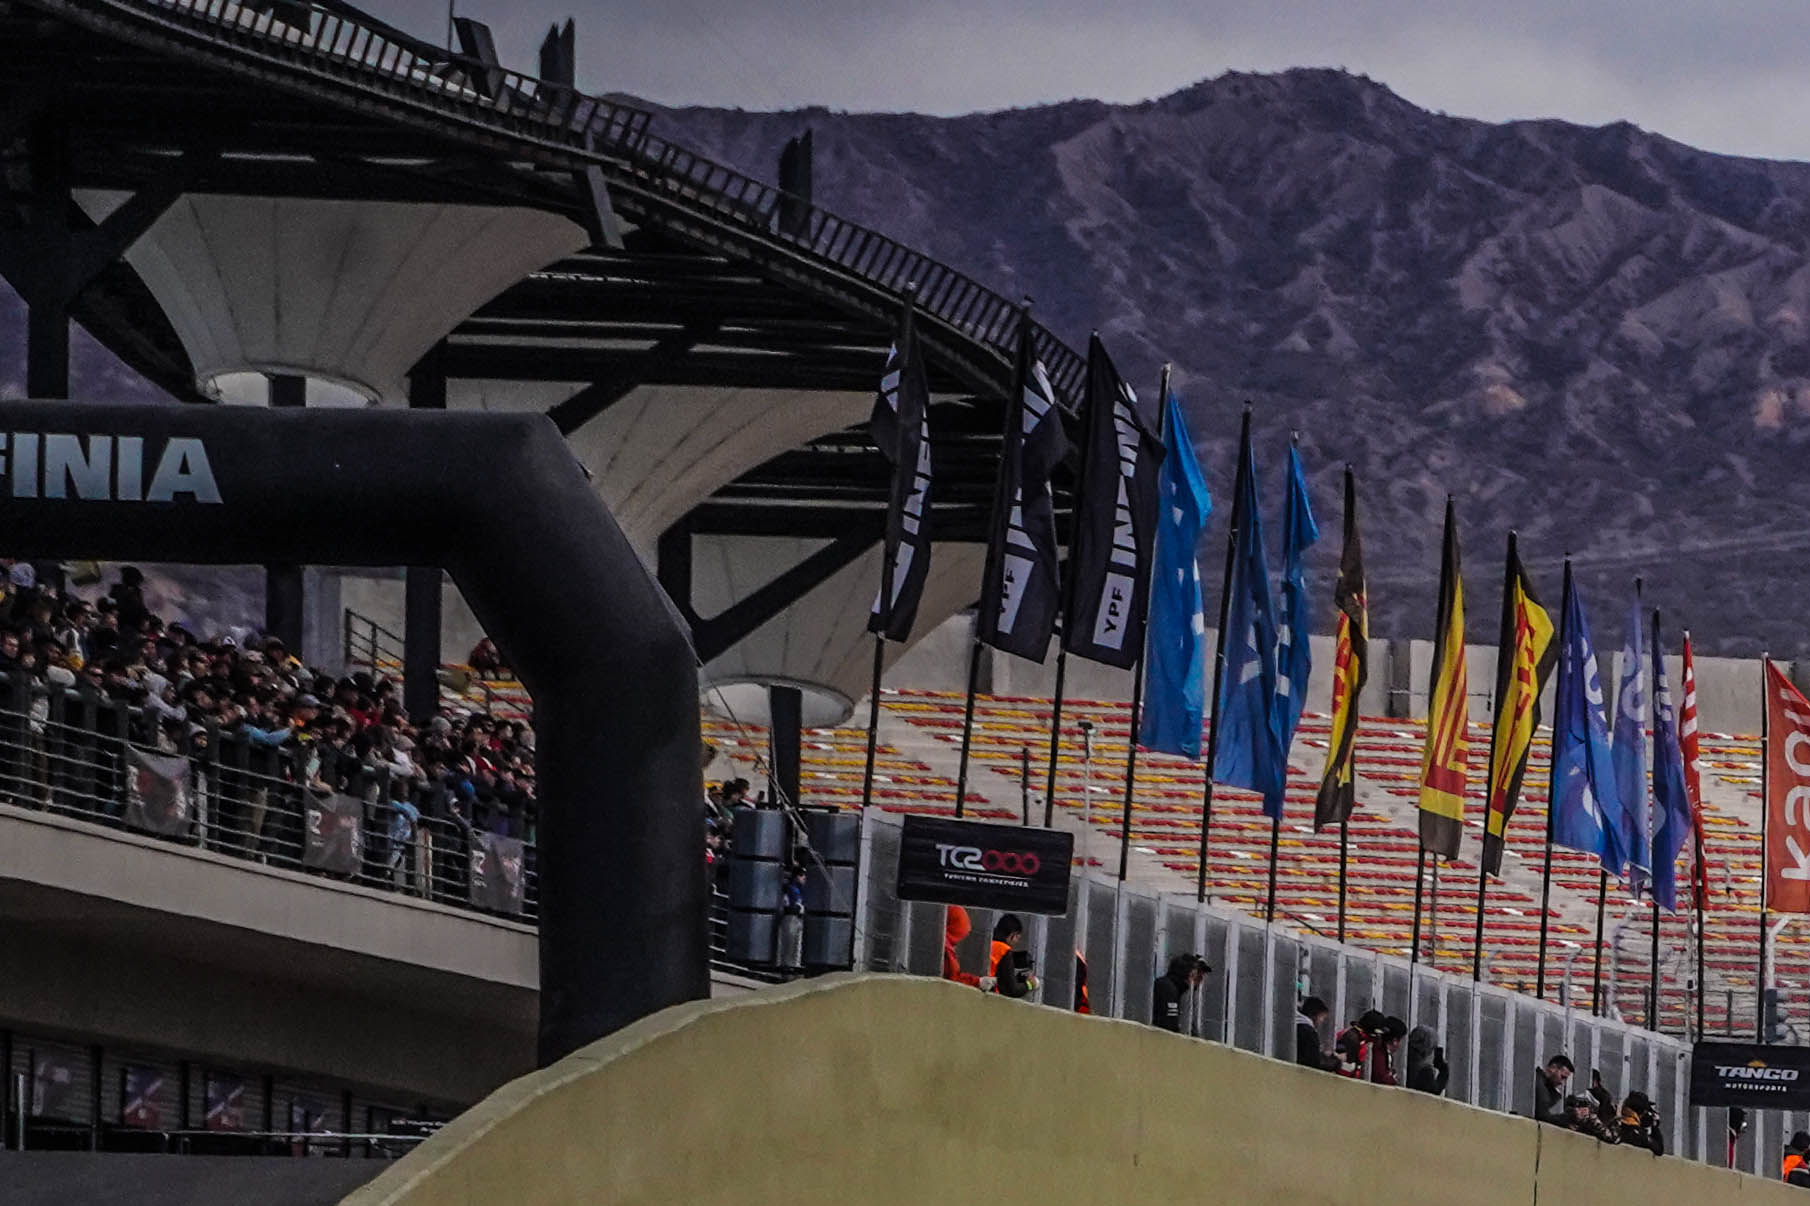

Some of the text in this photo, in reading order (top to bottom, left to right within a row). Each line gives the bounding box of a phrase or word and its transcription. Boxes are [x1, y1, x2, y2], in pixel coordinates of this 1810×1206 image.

[1104, 585, 1124, 634] YPF
[935, 844, 1040, 874] TC2000
[1714, 1065, 1799, 1080] TANGO
